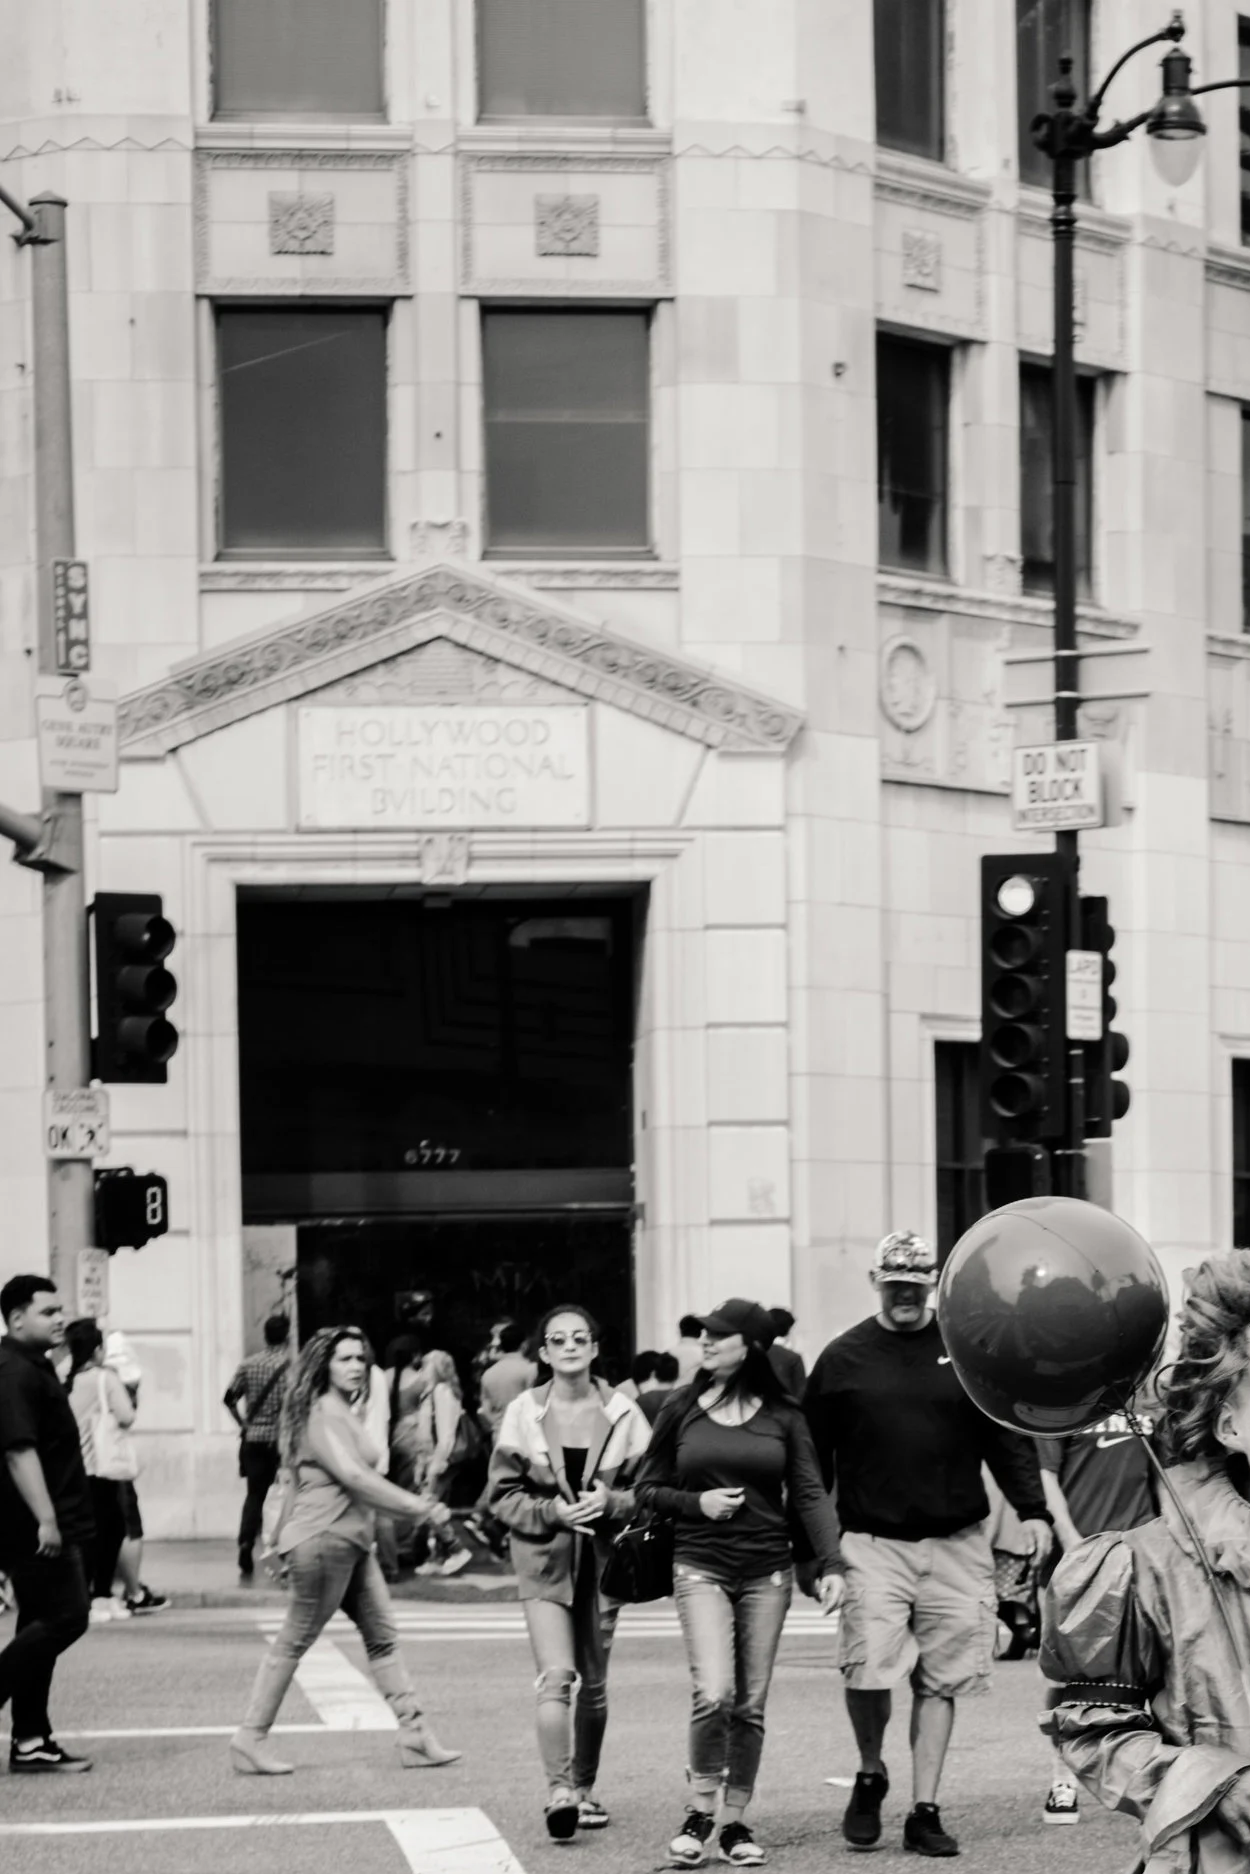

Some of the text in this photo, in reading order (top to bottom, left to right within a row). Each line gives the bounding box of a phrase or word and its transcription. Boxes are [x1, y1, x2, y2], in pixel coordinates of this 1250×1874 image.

[336, 718, 551, 747] HOLLYWOOD
[312, 752, 575, 781] FIRST NATIONAL
[1023, 748, 1087, 776] DO NOT
[1027, 777, 1083, 804] BLOCK
[1019, 805, 1095, 822] INTERSECTION
[49, 1125, 71, 1149] OK
[146, 1186, 163, 1225] 8
